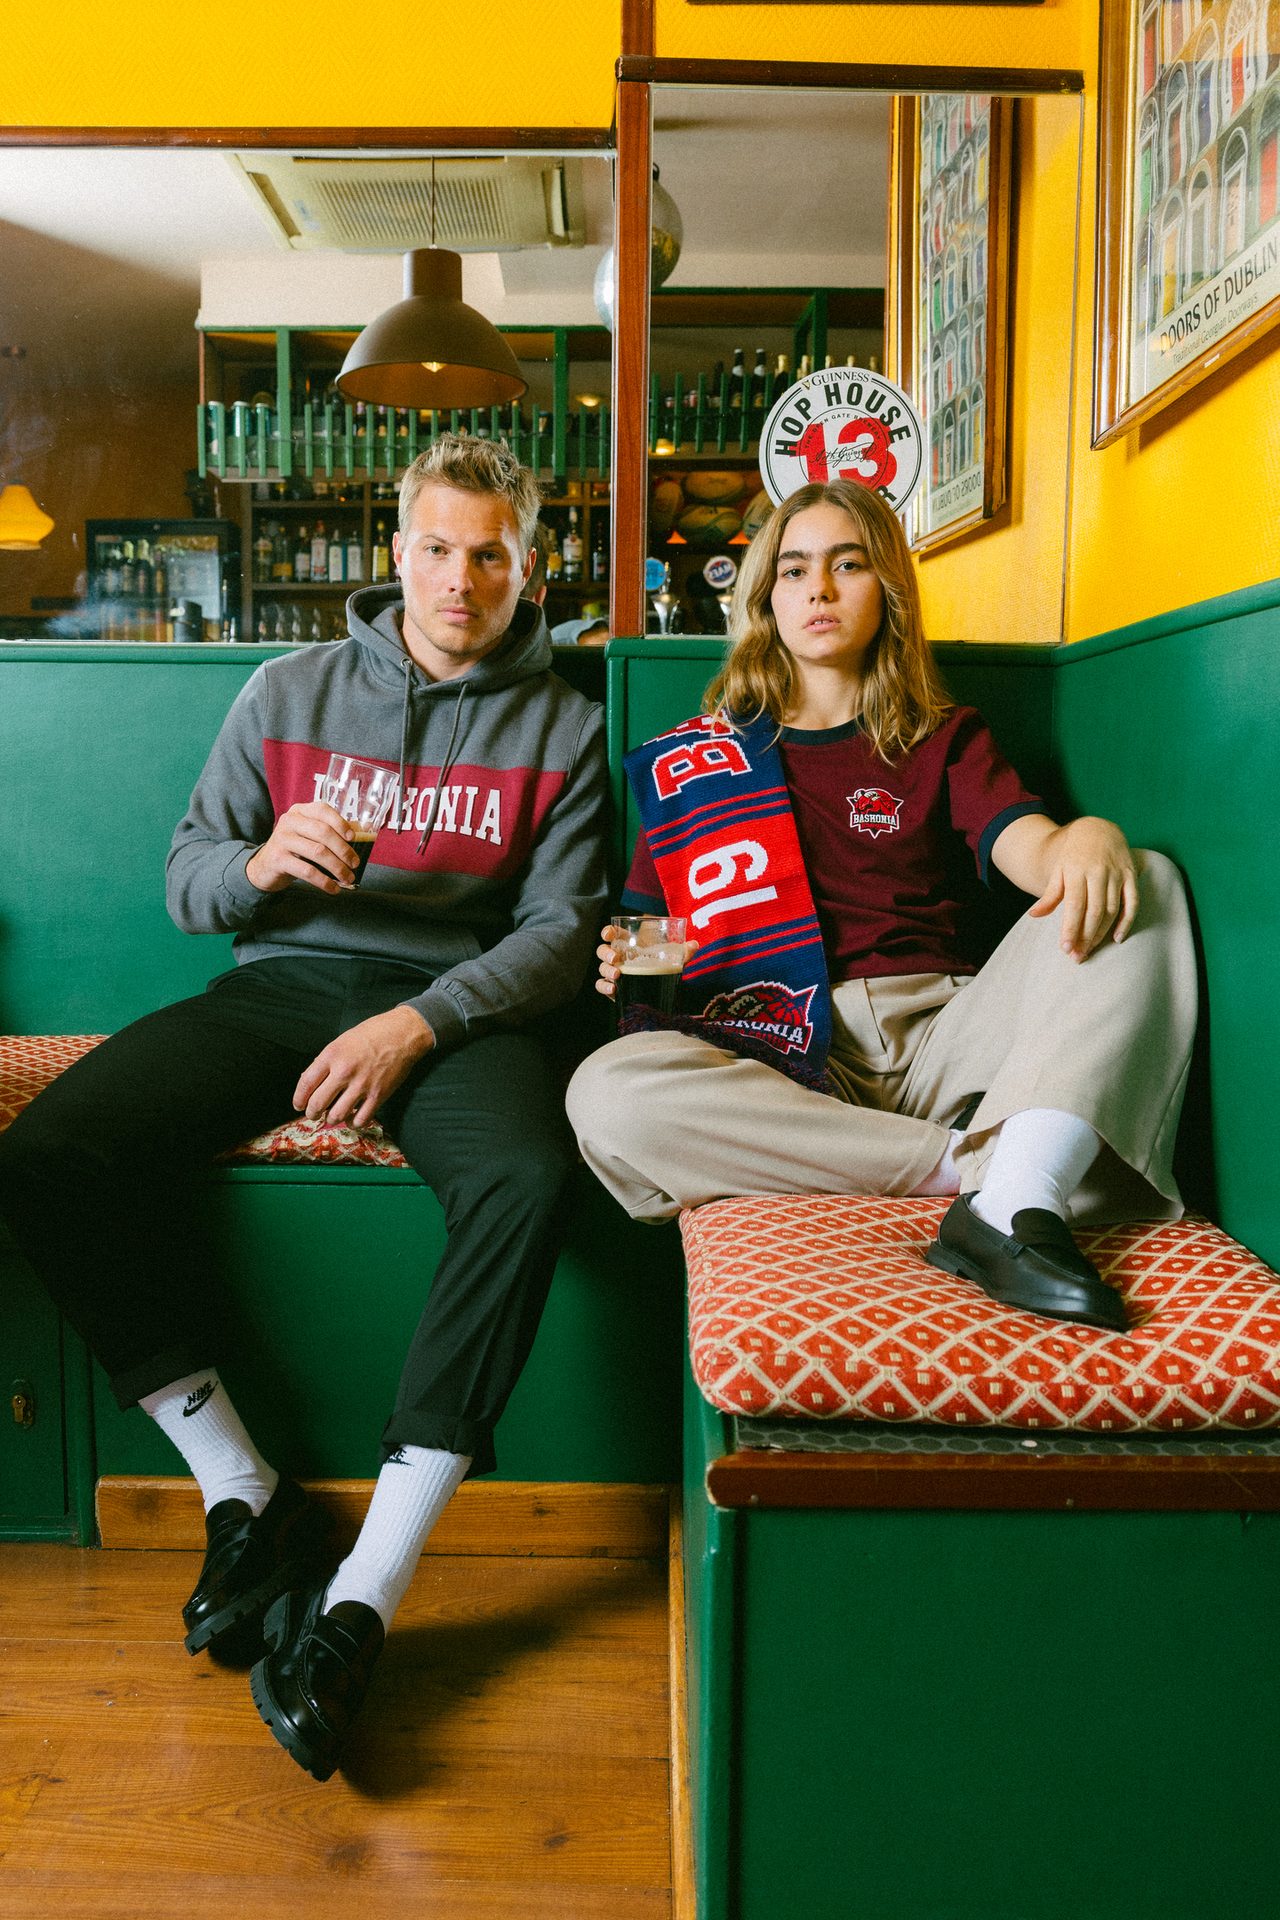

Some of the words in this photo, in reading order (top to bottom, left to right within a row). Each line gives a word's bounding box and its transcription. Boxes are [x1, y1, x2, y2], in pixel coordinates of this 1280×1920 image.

[1160, 303, 1200, 357] DOORS
[1203, 286, 1220, 320] OF
[1224, 236, 1278, 305] DUBLIN
[811, 371, 870, 387] GUINNESS
[774, 397, 812, 457] HOP
[824, 382, 912, 444] HOUSE
[789, 417, 898, 491] 13
[853, 813, 897, 825] BASKONIA
[688, 839, 778, 929] 19
[187, 1380, 211, 1407] NIKE
